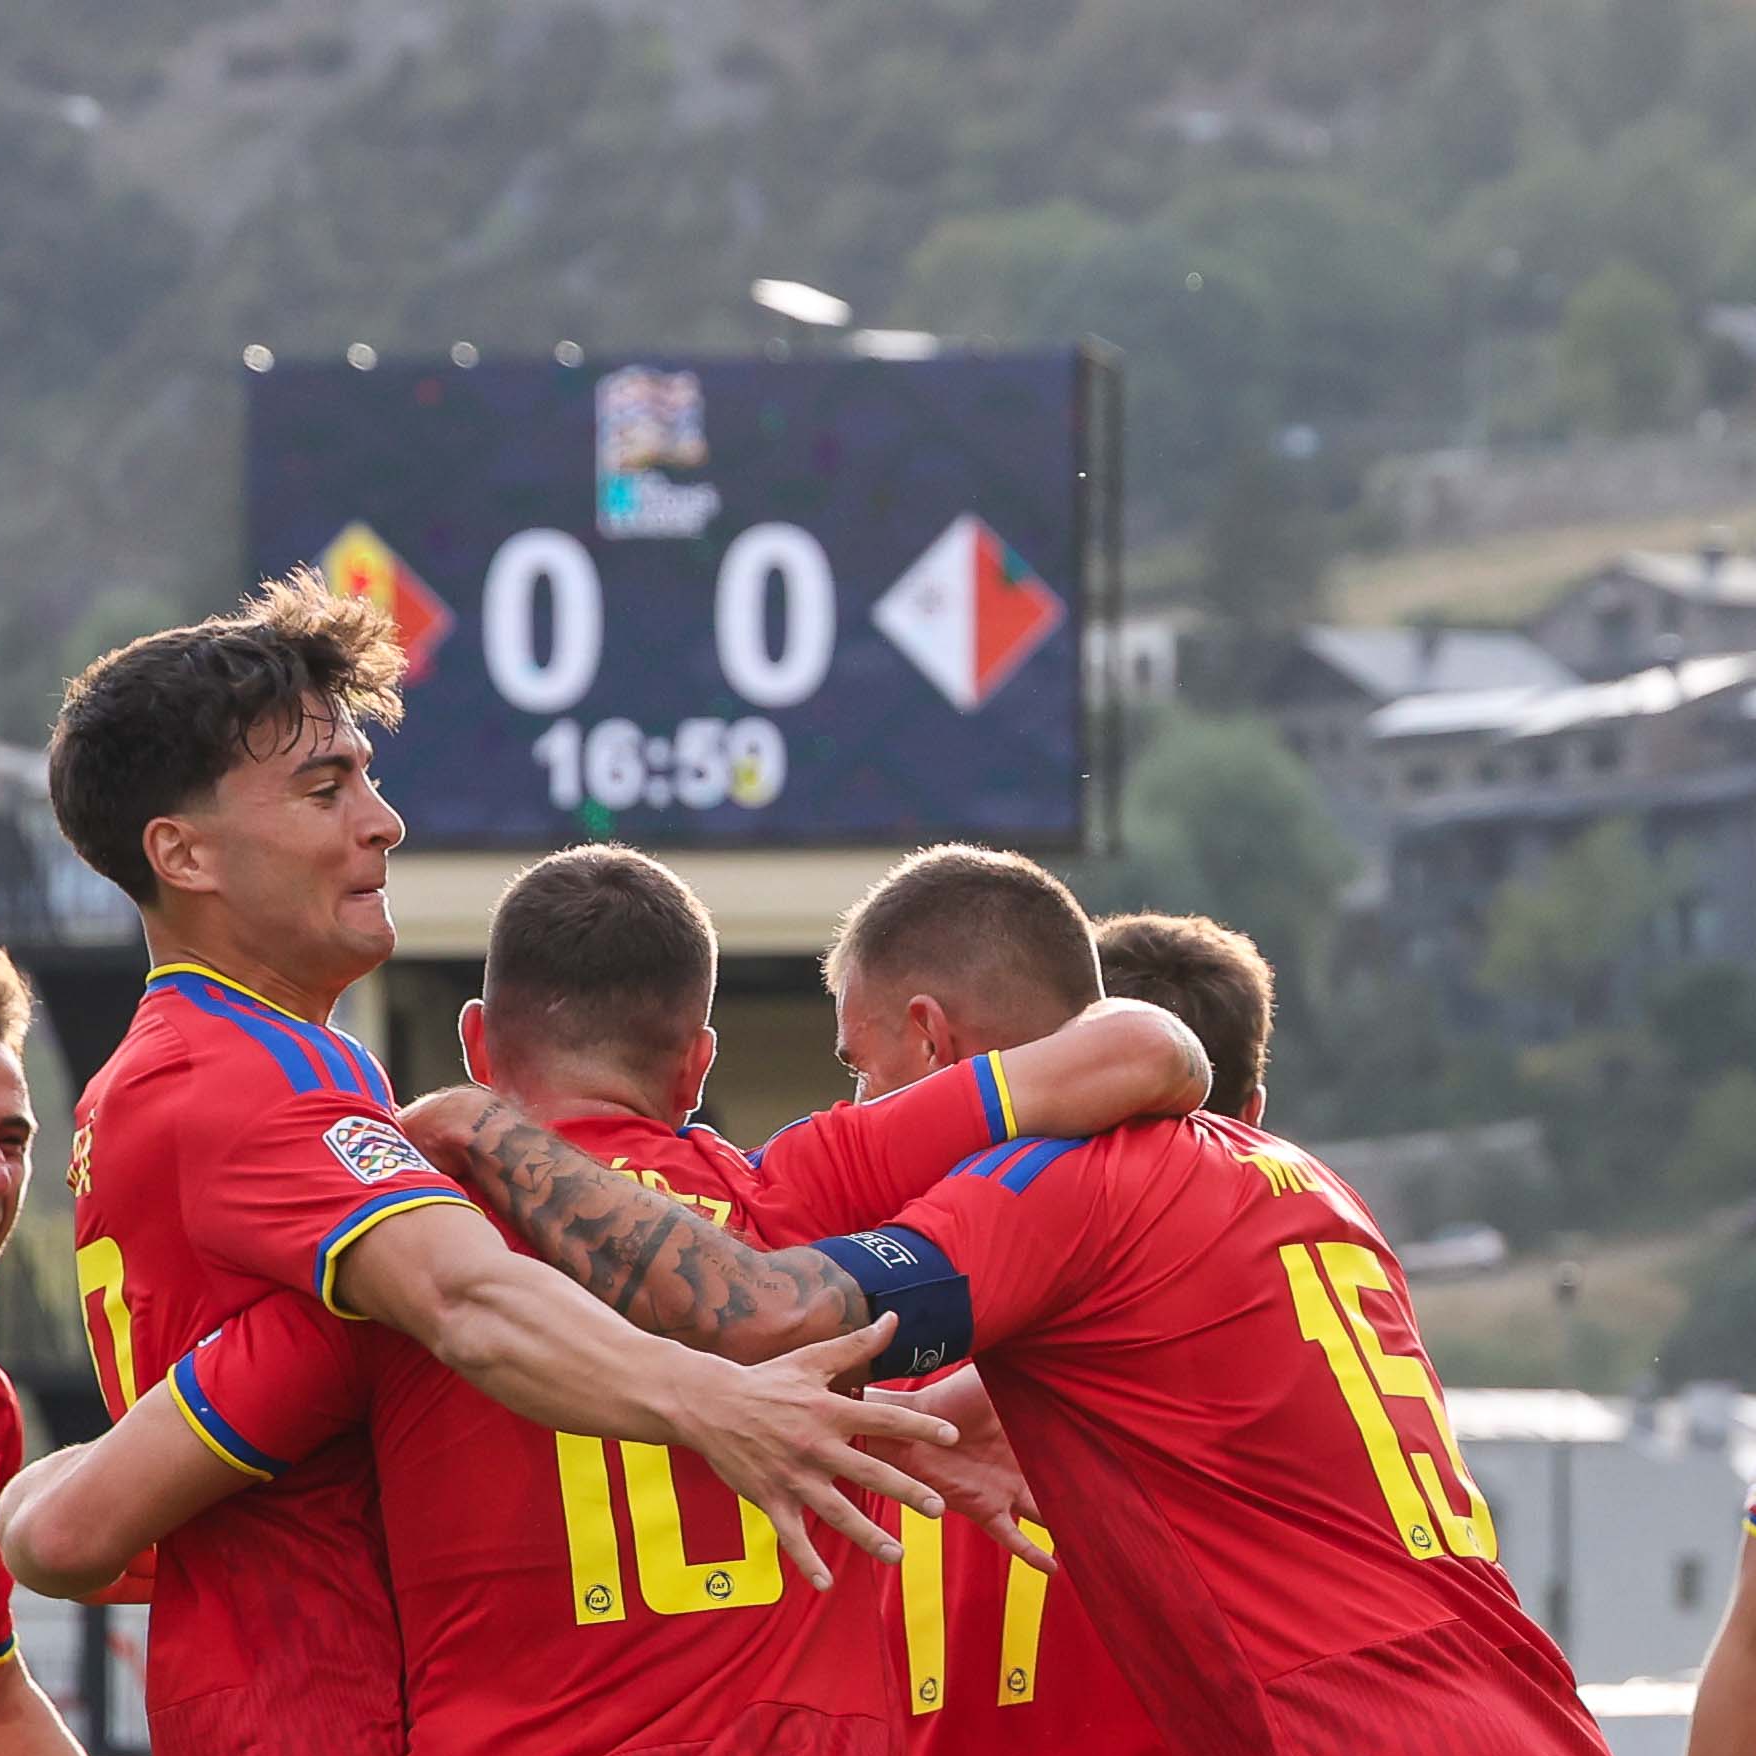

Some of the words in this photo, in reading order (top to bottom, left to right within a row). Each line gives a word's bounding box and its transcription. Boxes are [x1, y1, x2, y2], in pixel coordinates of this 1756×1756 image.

[482, 527, 604, 714] 0
[715, 522, 837, 709] 0
[849, 1231, 912, 1265] PECT
[1278, 1241, 1499, 1562] 15
[556, 1430, 785, 1627] 10
